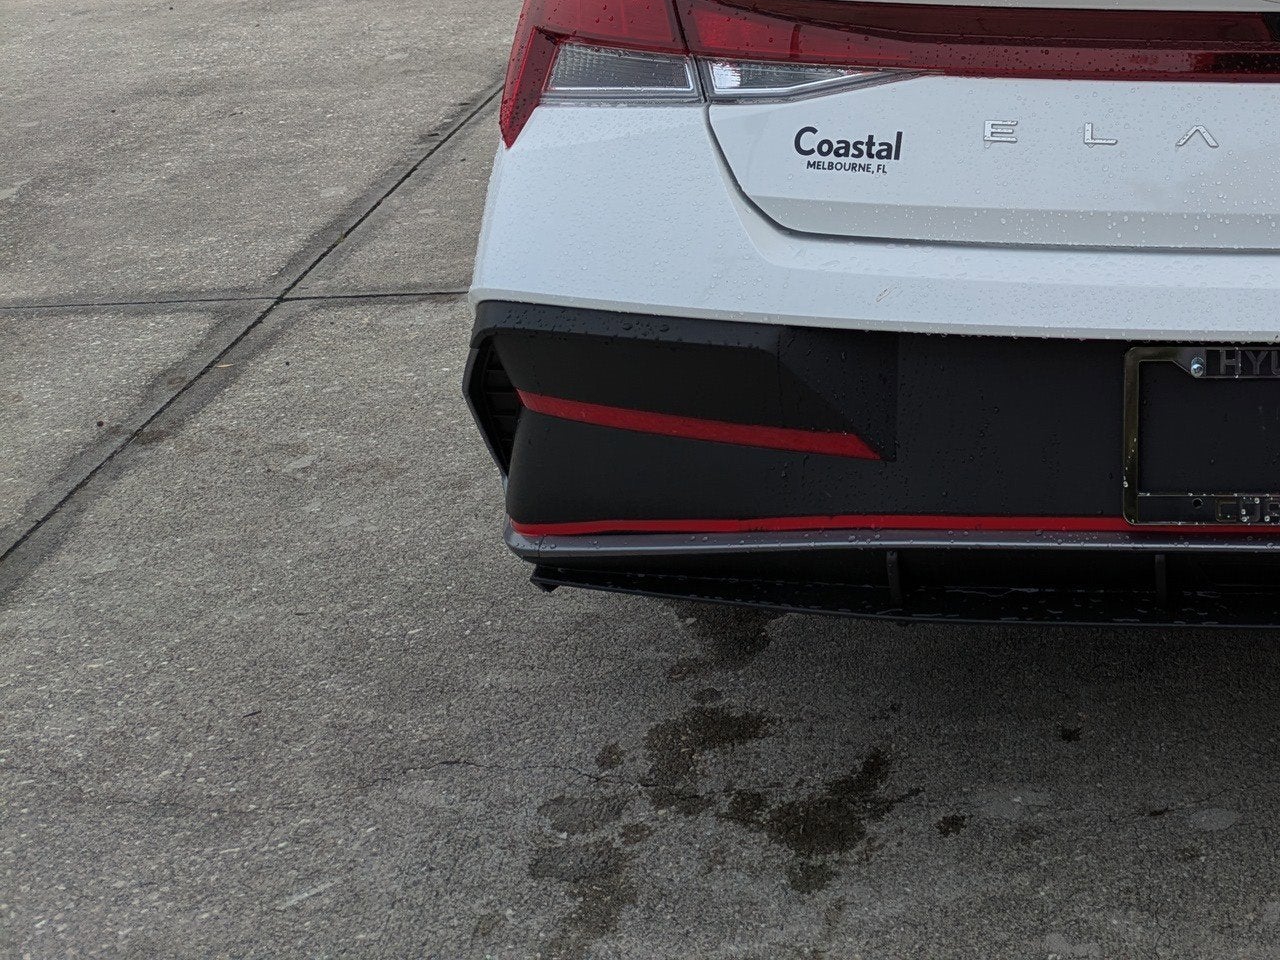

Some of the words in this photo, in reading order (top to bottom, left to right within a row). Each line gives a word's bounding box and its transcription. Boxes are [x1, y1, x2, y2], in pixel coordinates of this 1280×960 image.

[794, 126, 903, 161] Coastal
[806, 160, 875, 174] MELBOURNE,
[877, 164, 887, 174] FL
